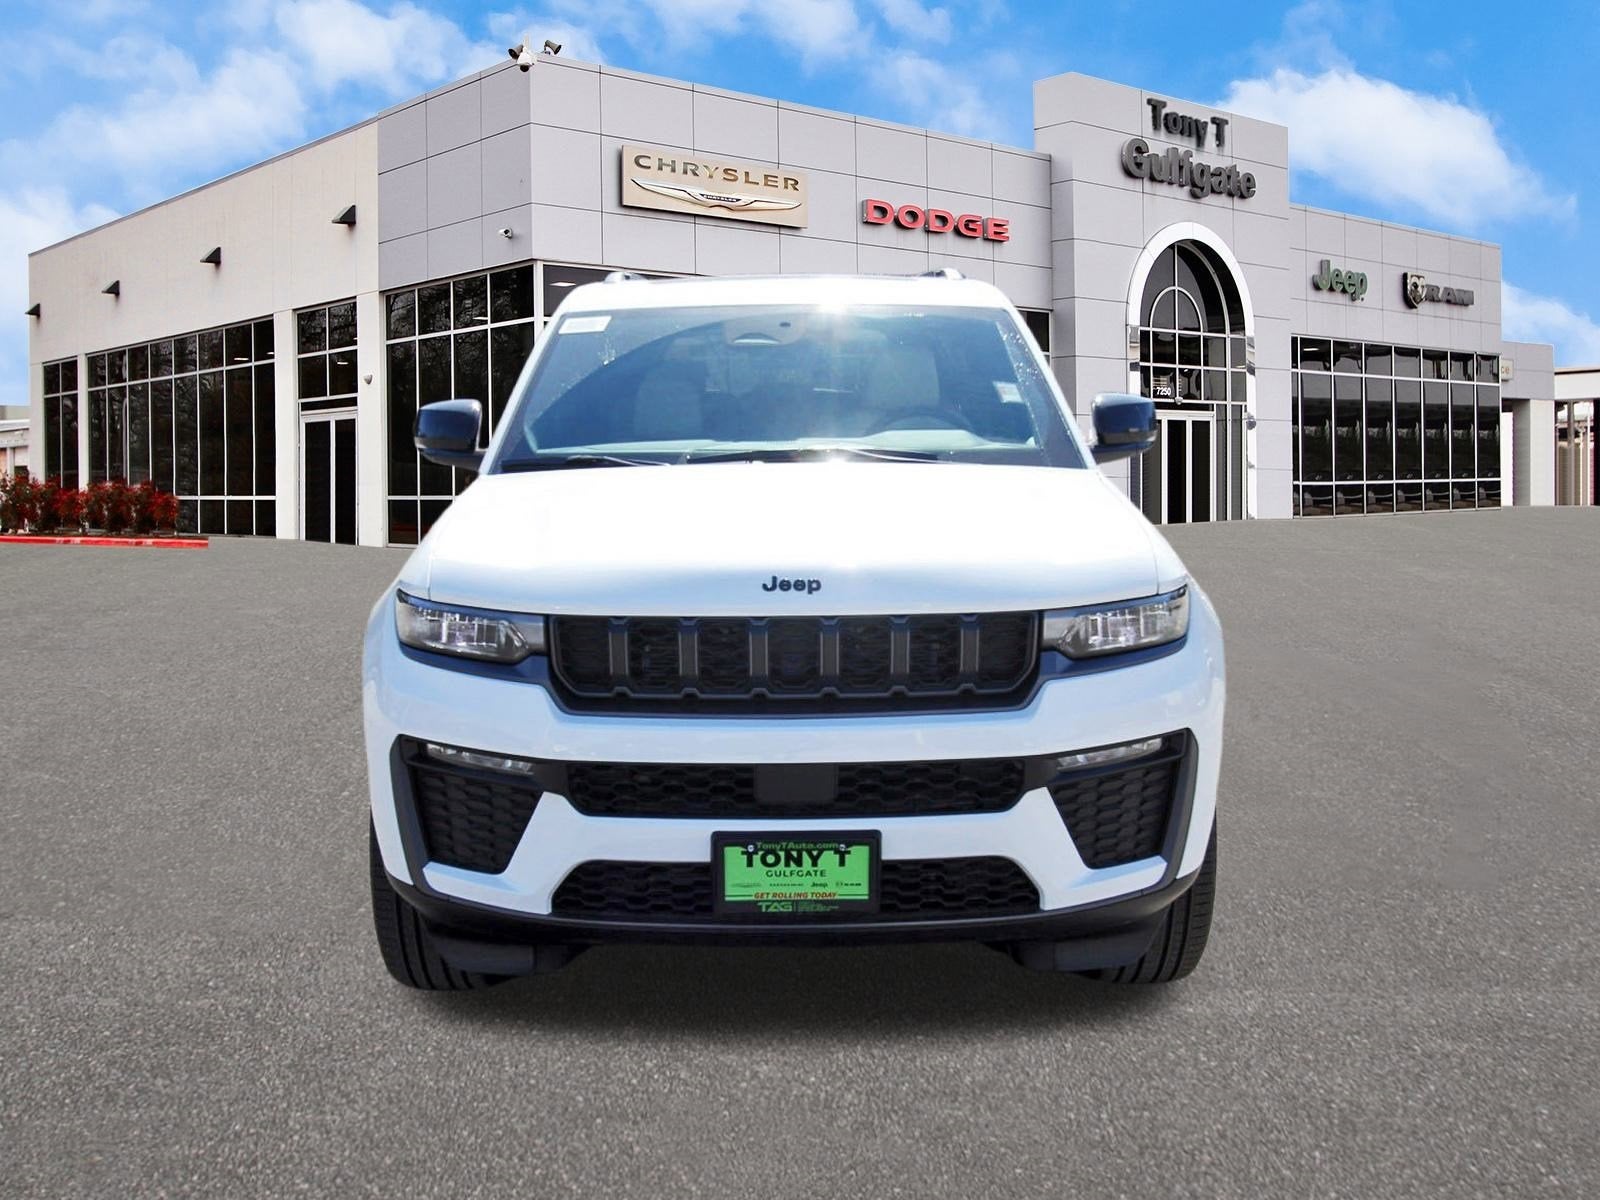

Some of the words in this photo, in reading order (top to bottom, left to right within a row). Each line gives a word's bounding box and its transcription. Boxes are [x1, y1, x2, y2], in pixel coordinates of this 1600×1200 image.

[1146, 98, 1208, 148] Tony
[1210, 116, 1229, 147] T
[634, 154, 800, 191] CHRYSLER
[1121, 138, 1256, 199] Gulfgate
[862, 199, 1010, 242] DODGE
[1312, 259, 1368, 302] Jeep
[1424, 284, 1475, 306] RAM
[1156, 386, 1172, 396] 7250
[762, 575, 822, 595] Jeep
[756, 841, 838, 850] TonyTAuto.com
[741, 850, 825, 868] TONY
[833, 849, 851, 867] T
[765, 870, 827, 878] GULFGATE
[811, 891, 837, 899] TODAY
